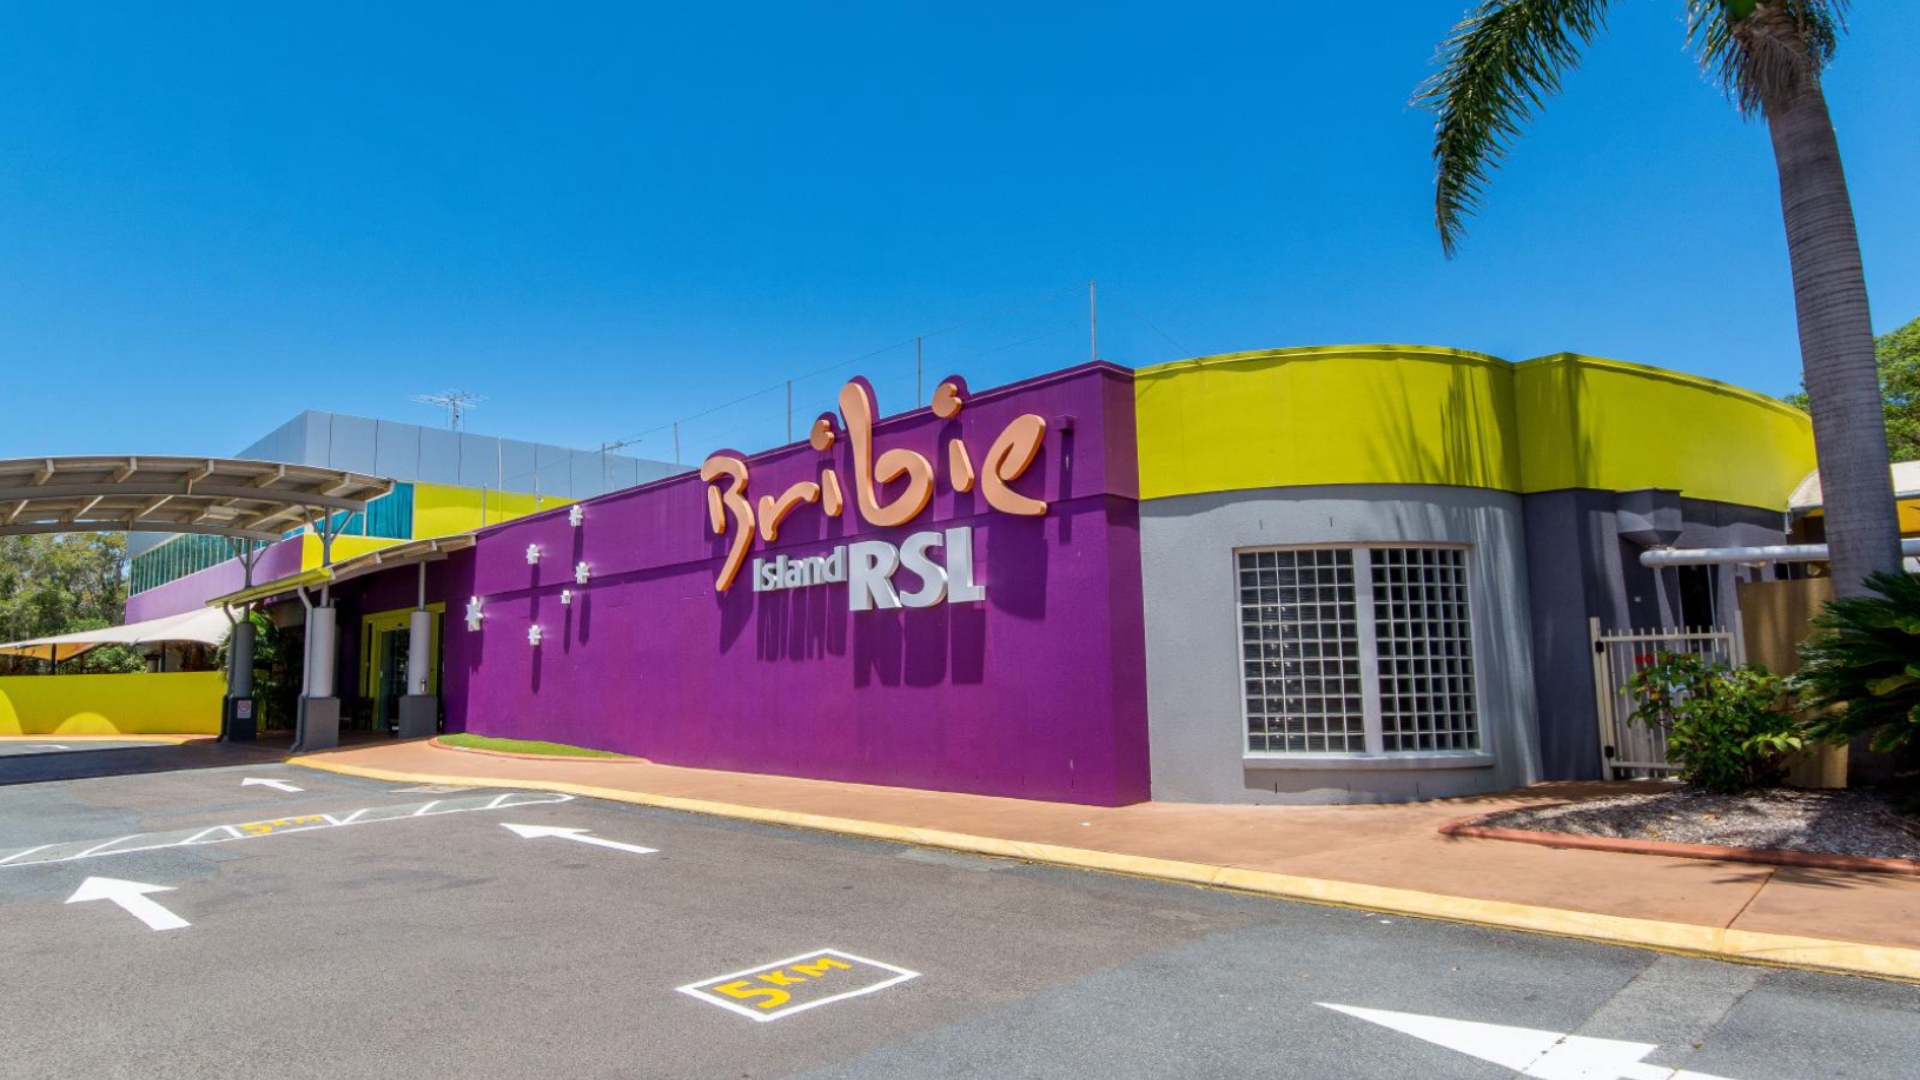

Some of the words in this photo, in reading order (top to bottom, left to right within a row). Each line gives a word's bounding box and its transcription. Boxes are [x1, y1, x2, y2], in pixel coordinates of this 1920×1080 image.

[701, 382, 1047, 592] Bribie
[753, 546, 847, 592] Island
[849, 527, 986, 611] RSL
